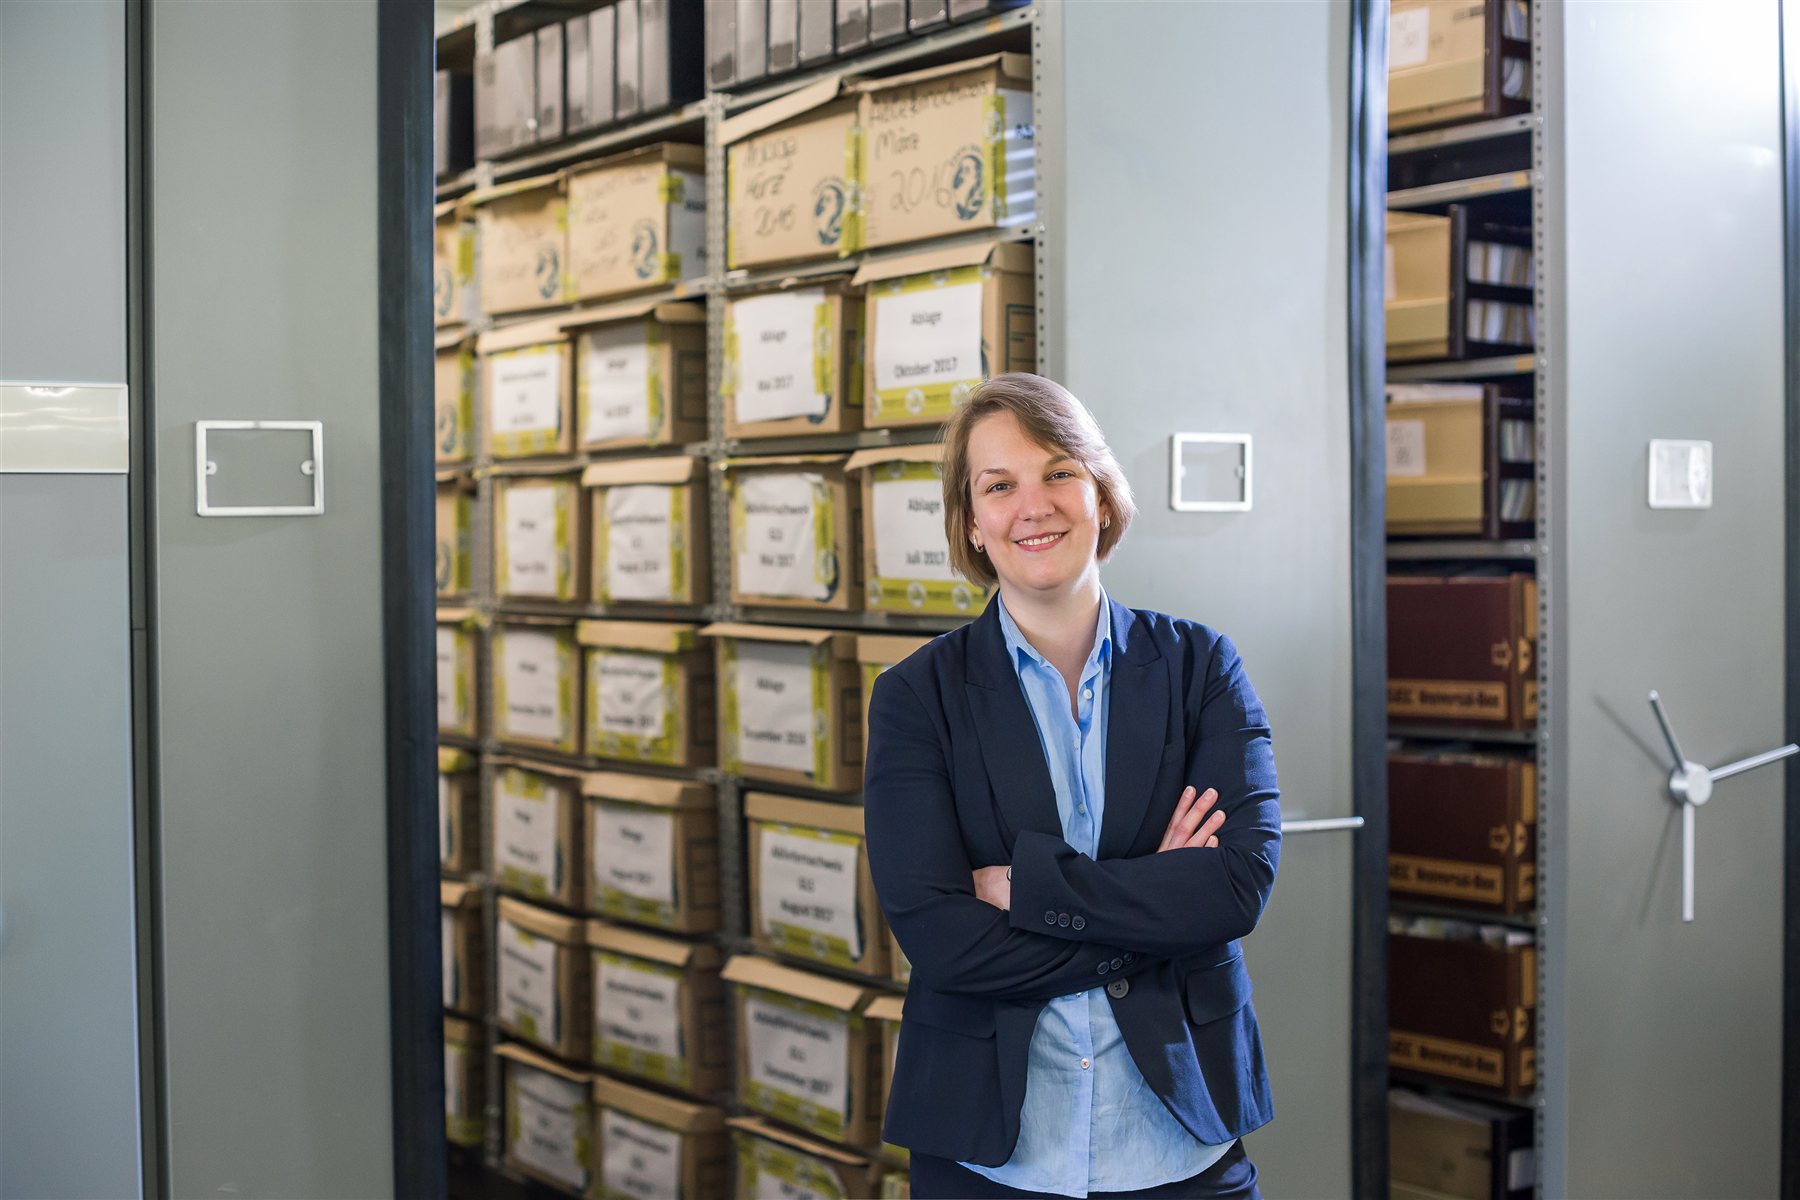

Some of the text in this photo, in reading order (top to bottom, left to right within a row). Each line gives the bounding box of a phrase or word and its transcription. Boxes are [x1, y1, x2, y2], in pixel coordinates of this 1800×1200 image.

[889, 163, 951, 213] 2016
[894, 356, 959, 379] Oktober 2017
[908, 498, 941, 515] Ablage
